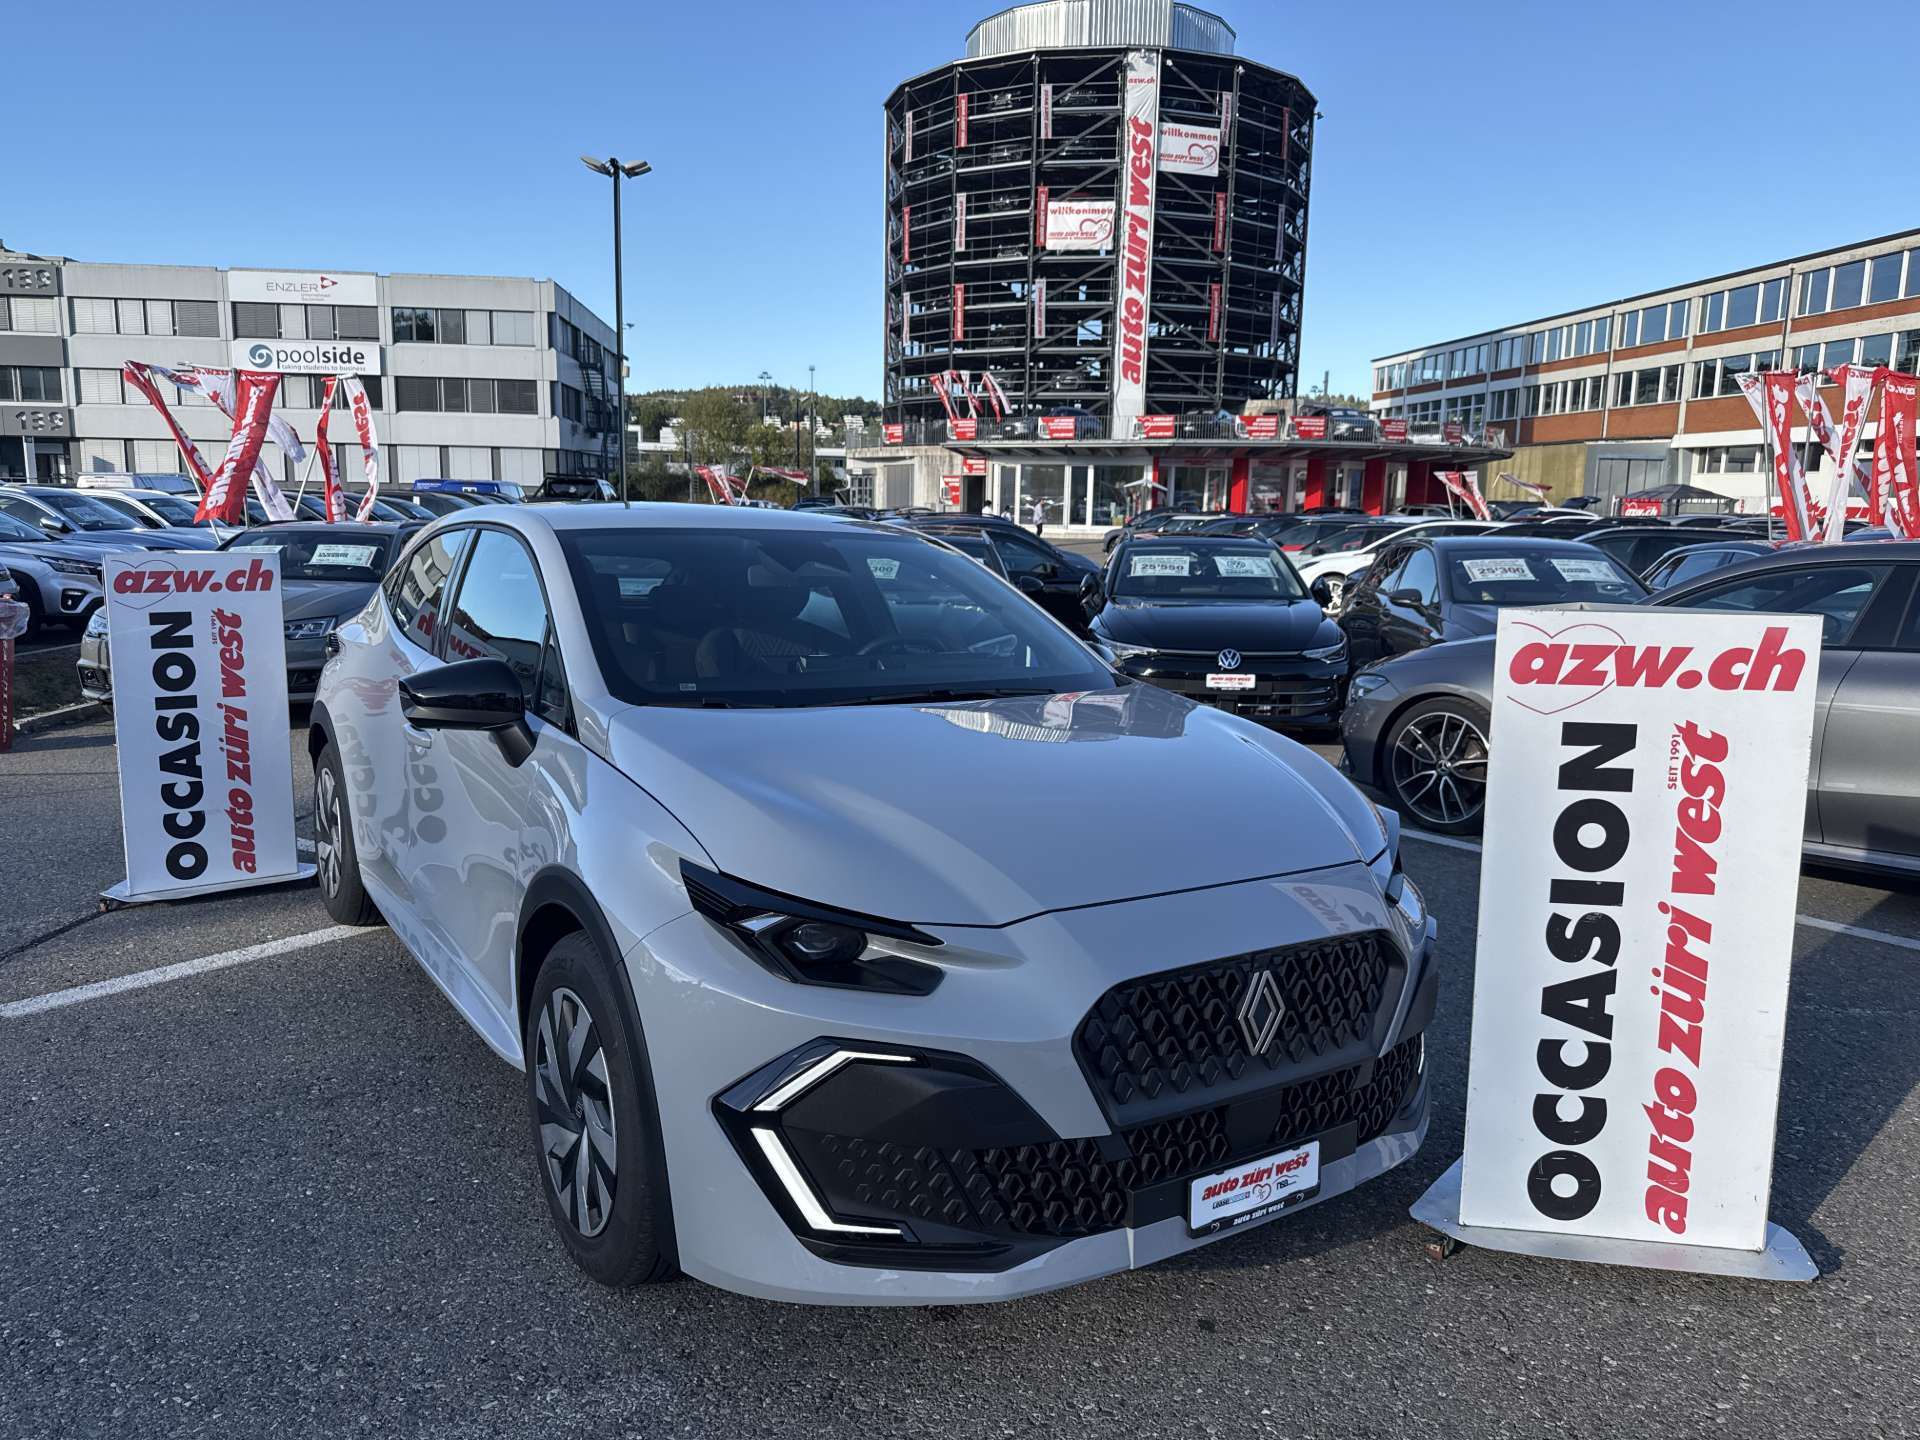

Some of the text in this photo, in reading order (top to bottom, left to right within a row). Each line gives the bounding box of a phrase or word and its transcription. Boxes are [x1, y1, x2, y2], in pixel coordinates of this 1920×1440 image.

[1161, 128, 1218, 141] willkommen
[1049, 206, 1113, 215] willkommen
[1121, 116, 1153, 385] auto züri west
[266, 282, 319, 292] ENZLER
[276, 345, 365, 369] poolside
[113, 559, 274, 594] azw.ch
[1509, 627, 1806, 692] azw.ch
[149, 612, 208, 880] OCCASION
[214, 609, 257, 874] auto züri west
[1667, 733, 1681, 790] SEIT 1991
[1528, 722, 1637, 1221] OCCASION
[1645, 719, 1729, 1235] auto züri west
[1202, 1151, 1310, 1201] auto züri west
[1233, 1214, 1250, 1225] auto
[1268, 1201, 1285, 1213] west
